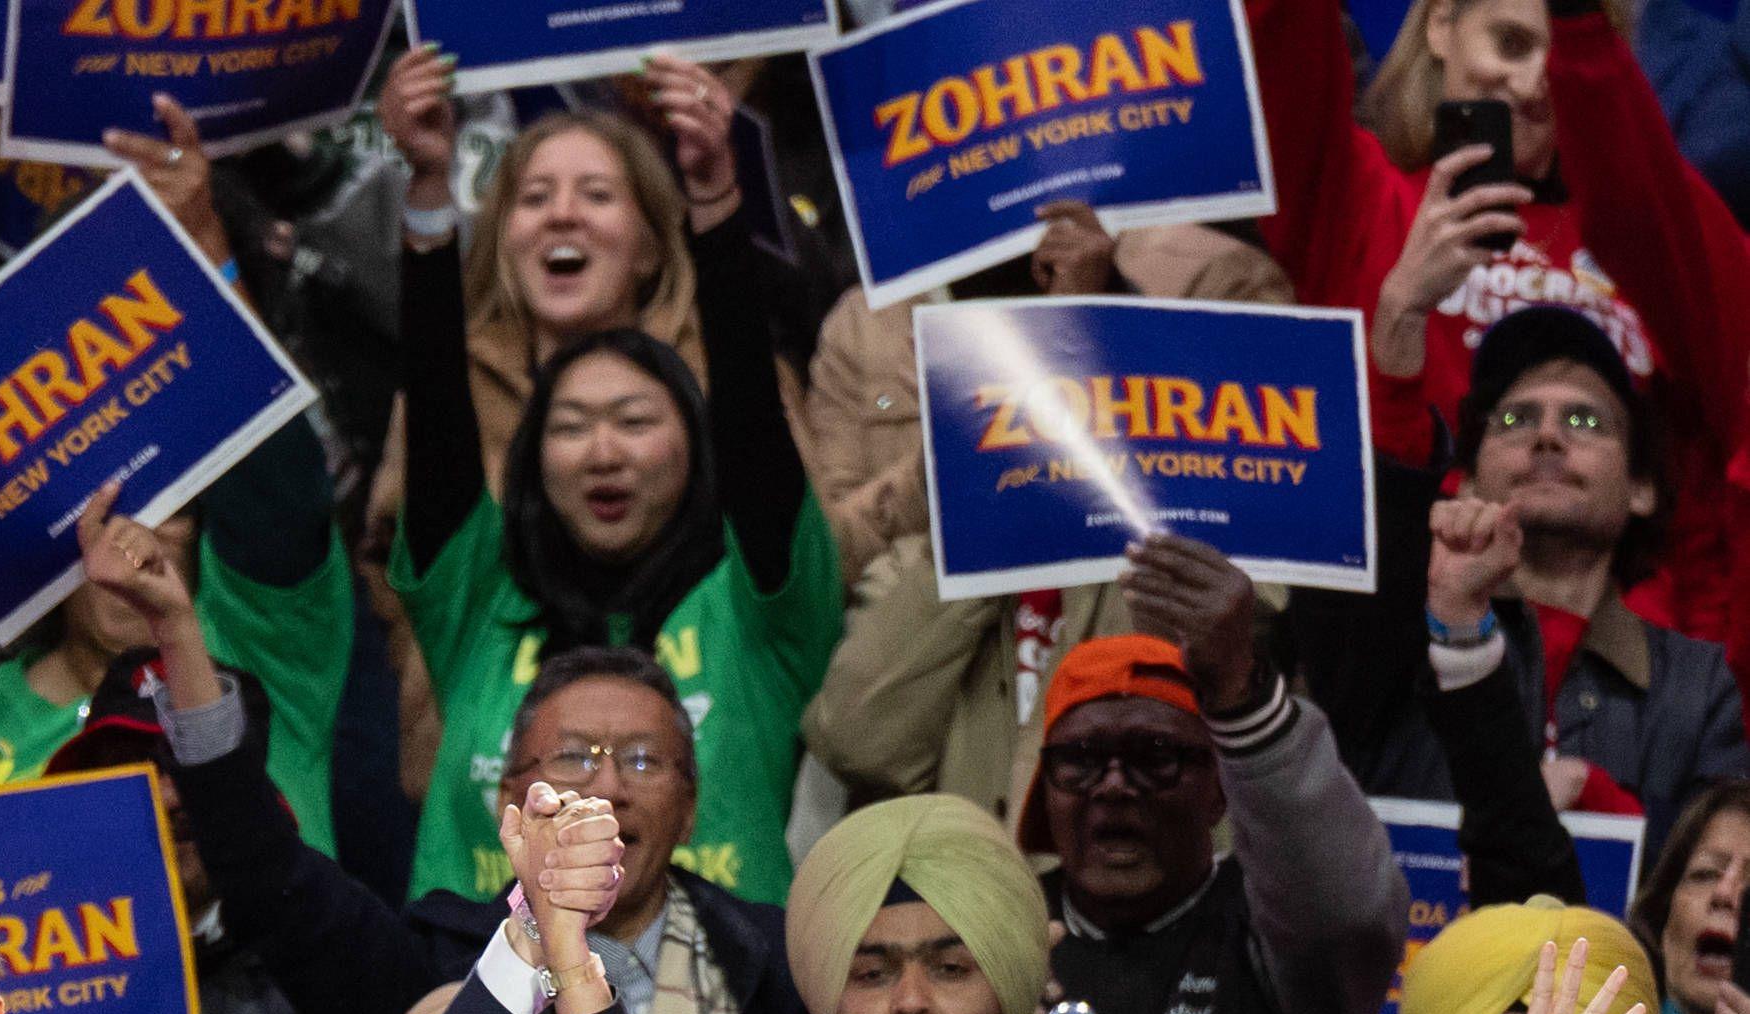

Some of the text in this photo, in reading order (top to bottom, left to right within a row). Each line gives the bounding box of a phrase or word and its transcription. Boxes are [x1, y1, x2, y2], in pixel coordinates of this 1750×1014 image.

[873, 19, 1205, 168] ZOHRAN
[948, 133, 1023, 181] NEW
[1025, 114, 1115, 151] YORK
[1117, 99, 1195, 133] CITY
[45, 400, 132, 468] YORK
[125, 341, 194, 407] CITY
[974, 374, 1322, 452] ZOHRAN
[1135, 451, 1227, 480] YORK
[1233, 457, 1309, 487] CITY
[57, 971, 130, 1006] CITY
